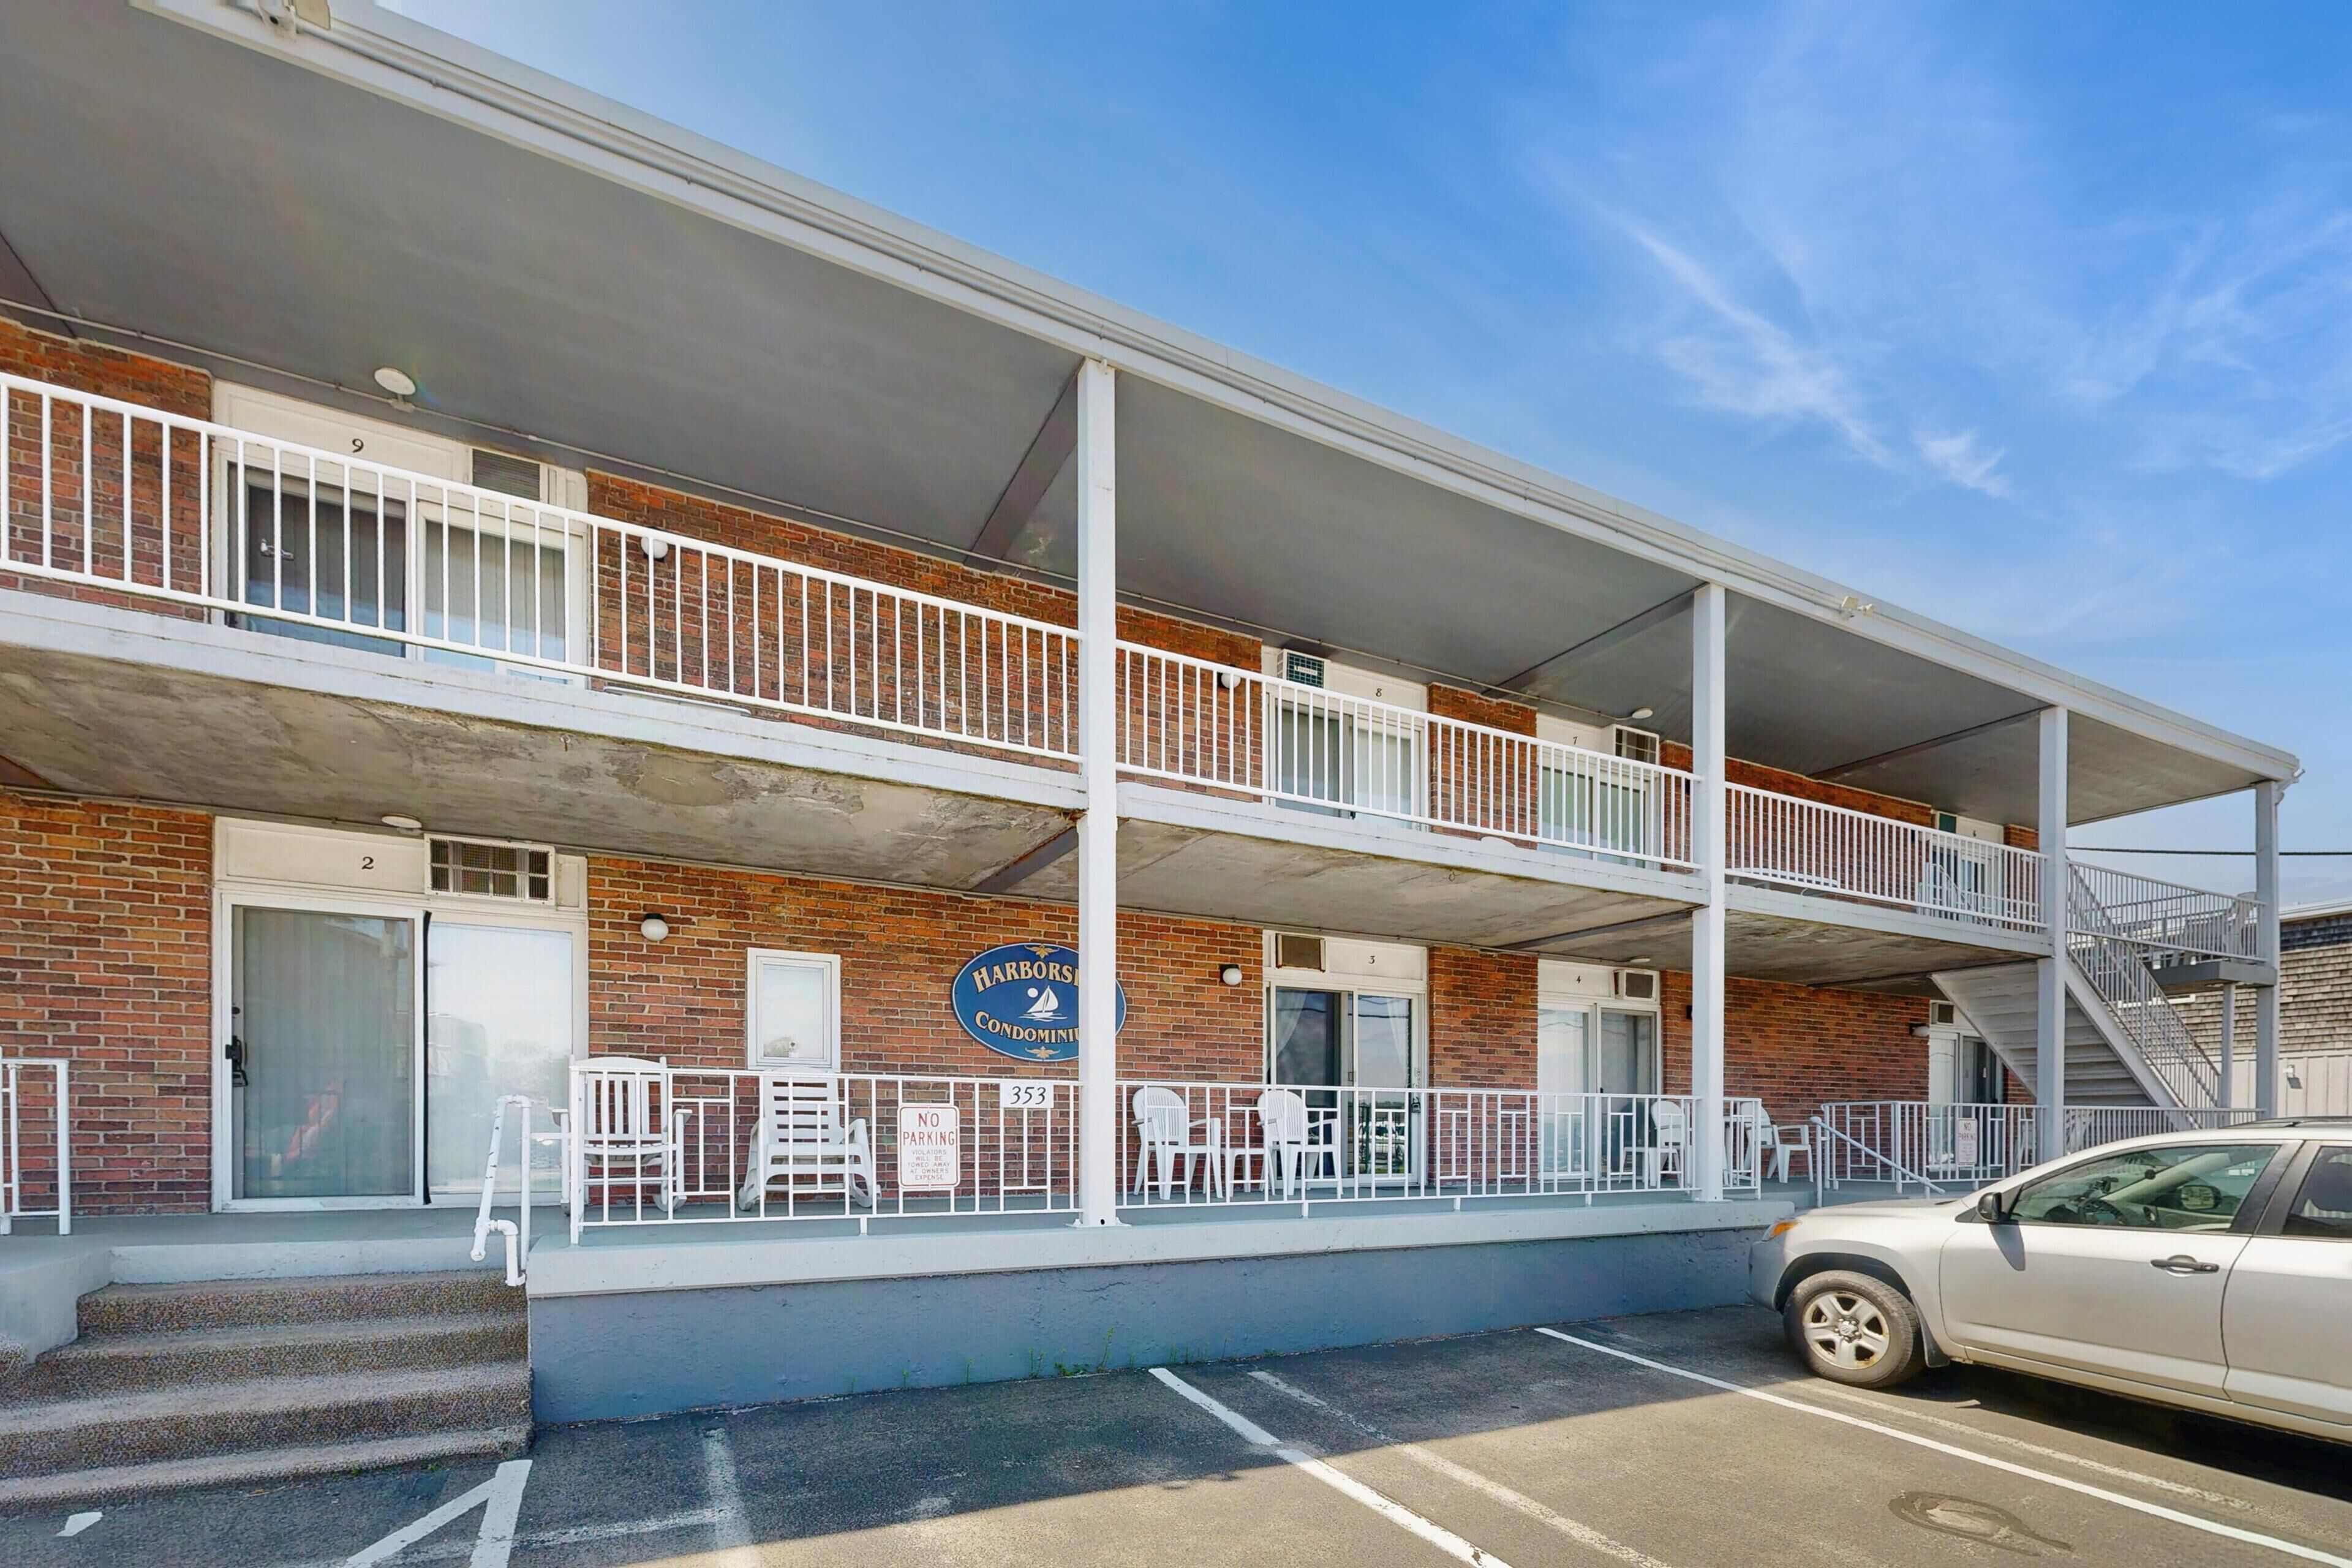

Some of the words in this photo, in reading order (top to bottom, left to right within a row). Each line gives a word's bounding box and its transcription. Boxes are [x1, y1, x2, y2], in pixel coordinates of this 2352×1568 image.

[352, 439, 364, 453] 9
[1376, 688, 1382, 697] 8
[1573, 736, 1578, 745] 7
[361, 856, 374, 870] 2
[1368, 955, 1375, 964] 3
[1576, 975, 1581, 984] 4
[1010, 1086, 1046, 1104] 353
[918, 1113, 939, 1127] NO
[1964, 1122, 1970, 1131] NO
[903, 1131, 954, 1145] PARKING
